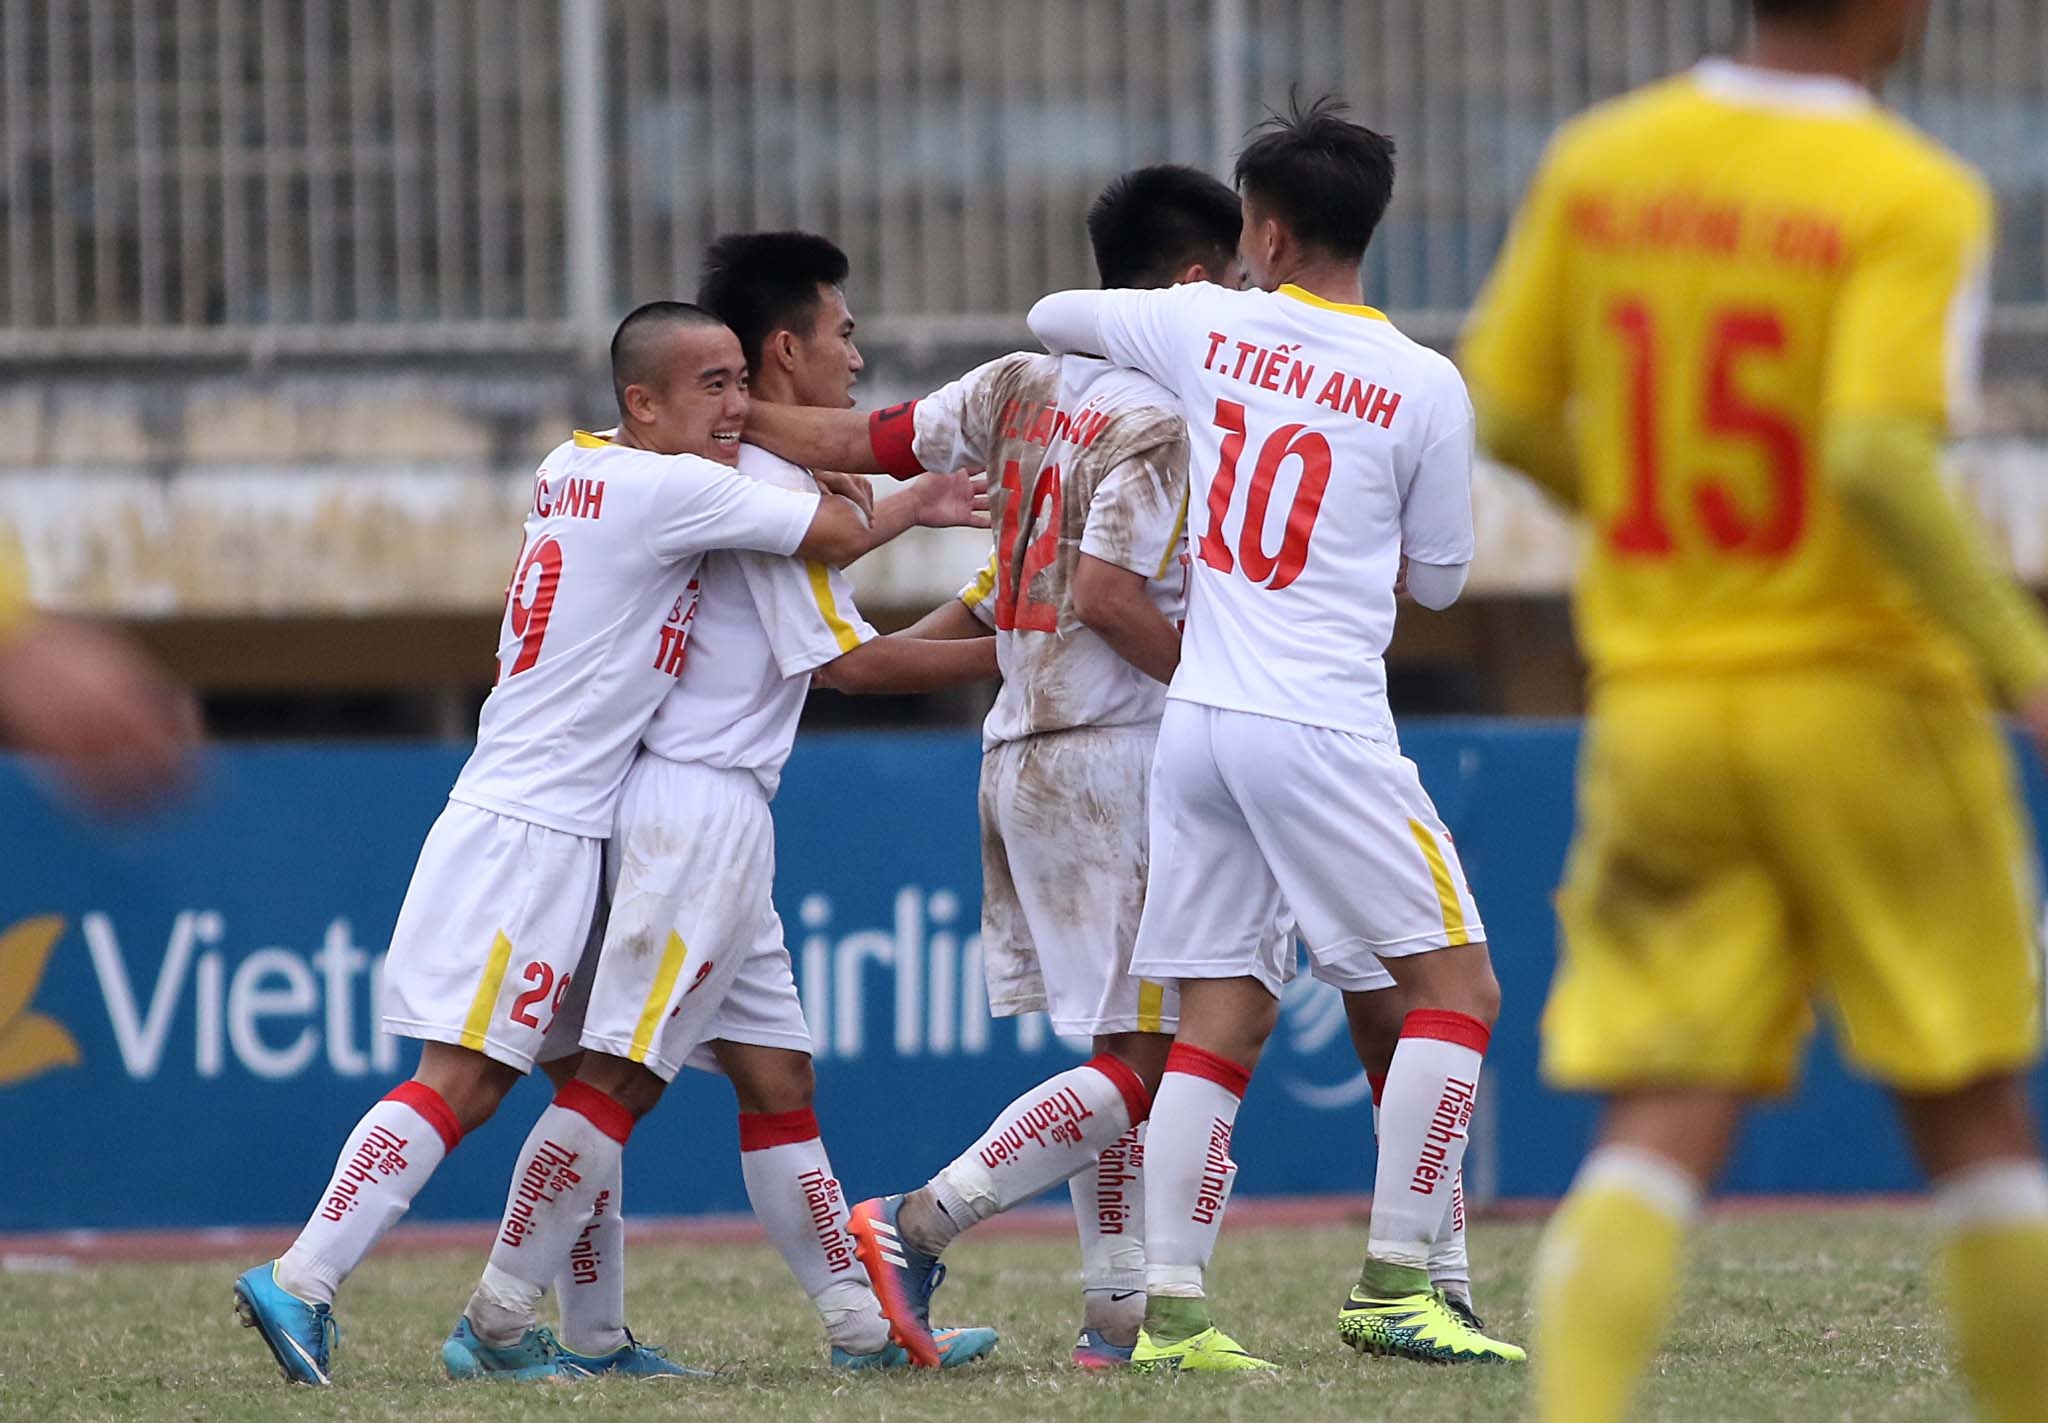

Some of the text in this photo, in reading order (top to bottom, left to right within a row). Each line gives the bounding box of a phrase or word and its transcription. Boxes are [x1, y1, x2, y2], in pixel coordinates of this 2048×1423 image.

[1204, 331, 1402, 429] T.TIẾN ANH
[1607, 296, 1810, 557] 15
[552, 478, 605, 519] ANH
[1197, 398, 1333, 591] 10
[995, 460, 1063, 632] 12
[496, 533, 563, 686] 9
[1016, 1086, 1094, 1148] Thanh
[1427, 1077, 1475, 1144] Thanh
[344, 1125, 408, 1184] Thanh
[518, 1140, 579, 1202] Thanh
[798, 1168, 840, 1231] Thanh
